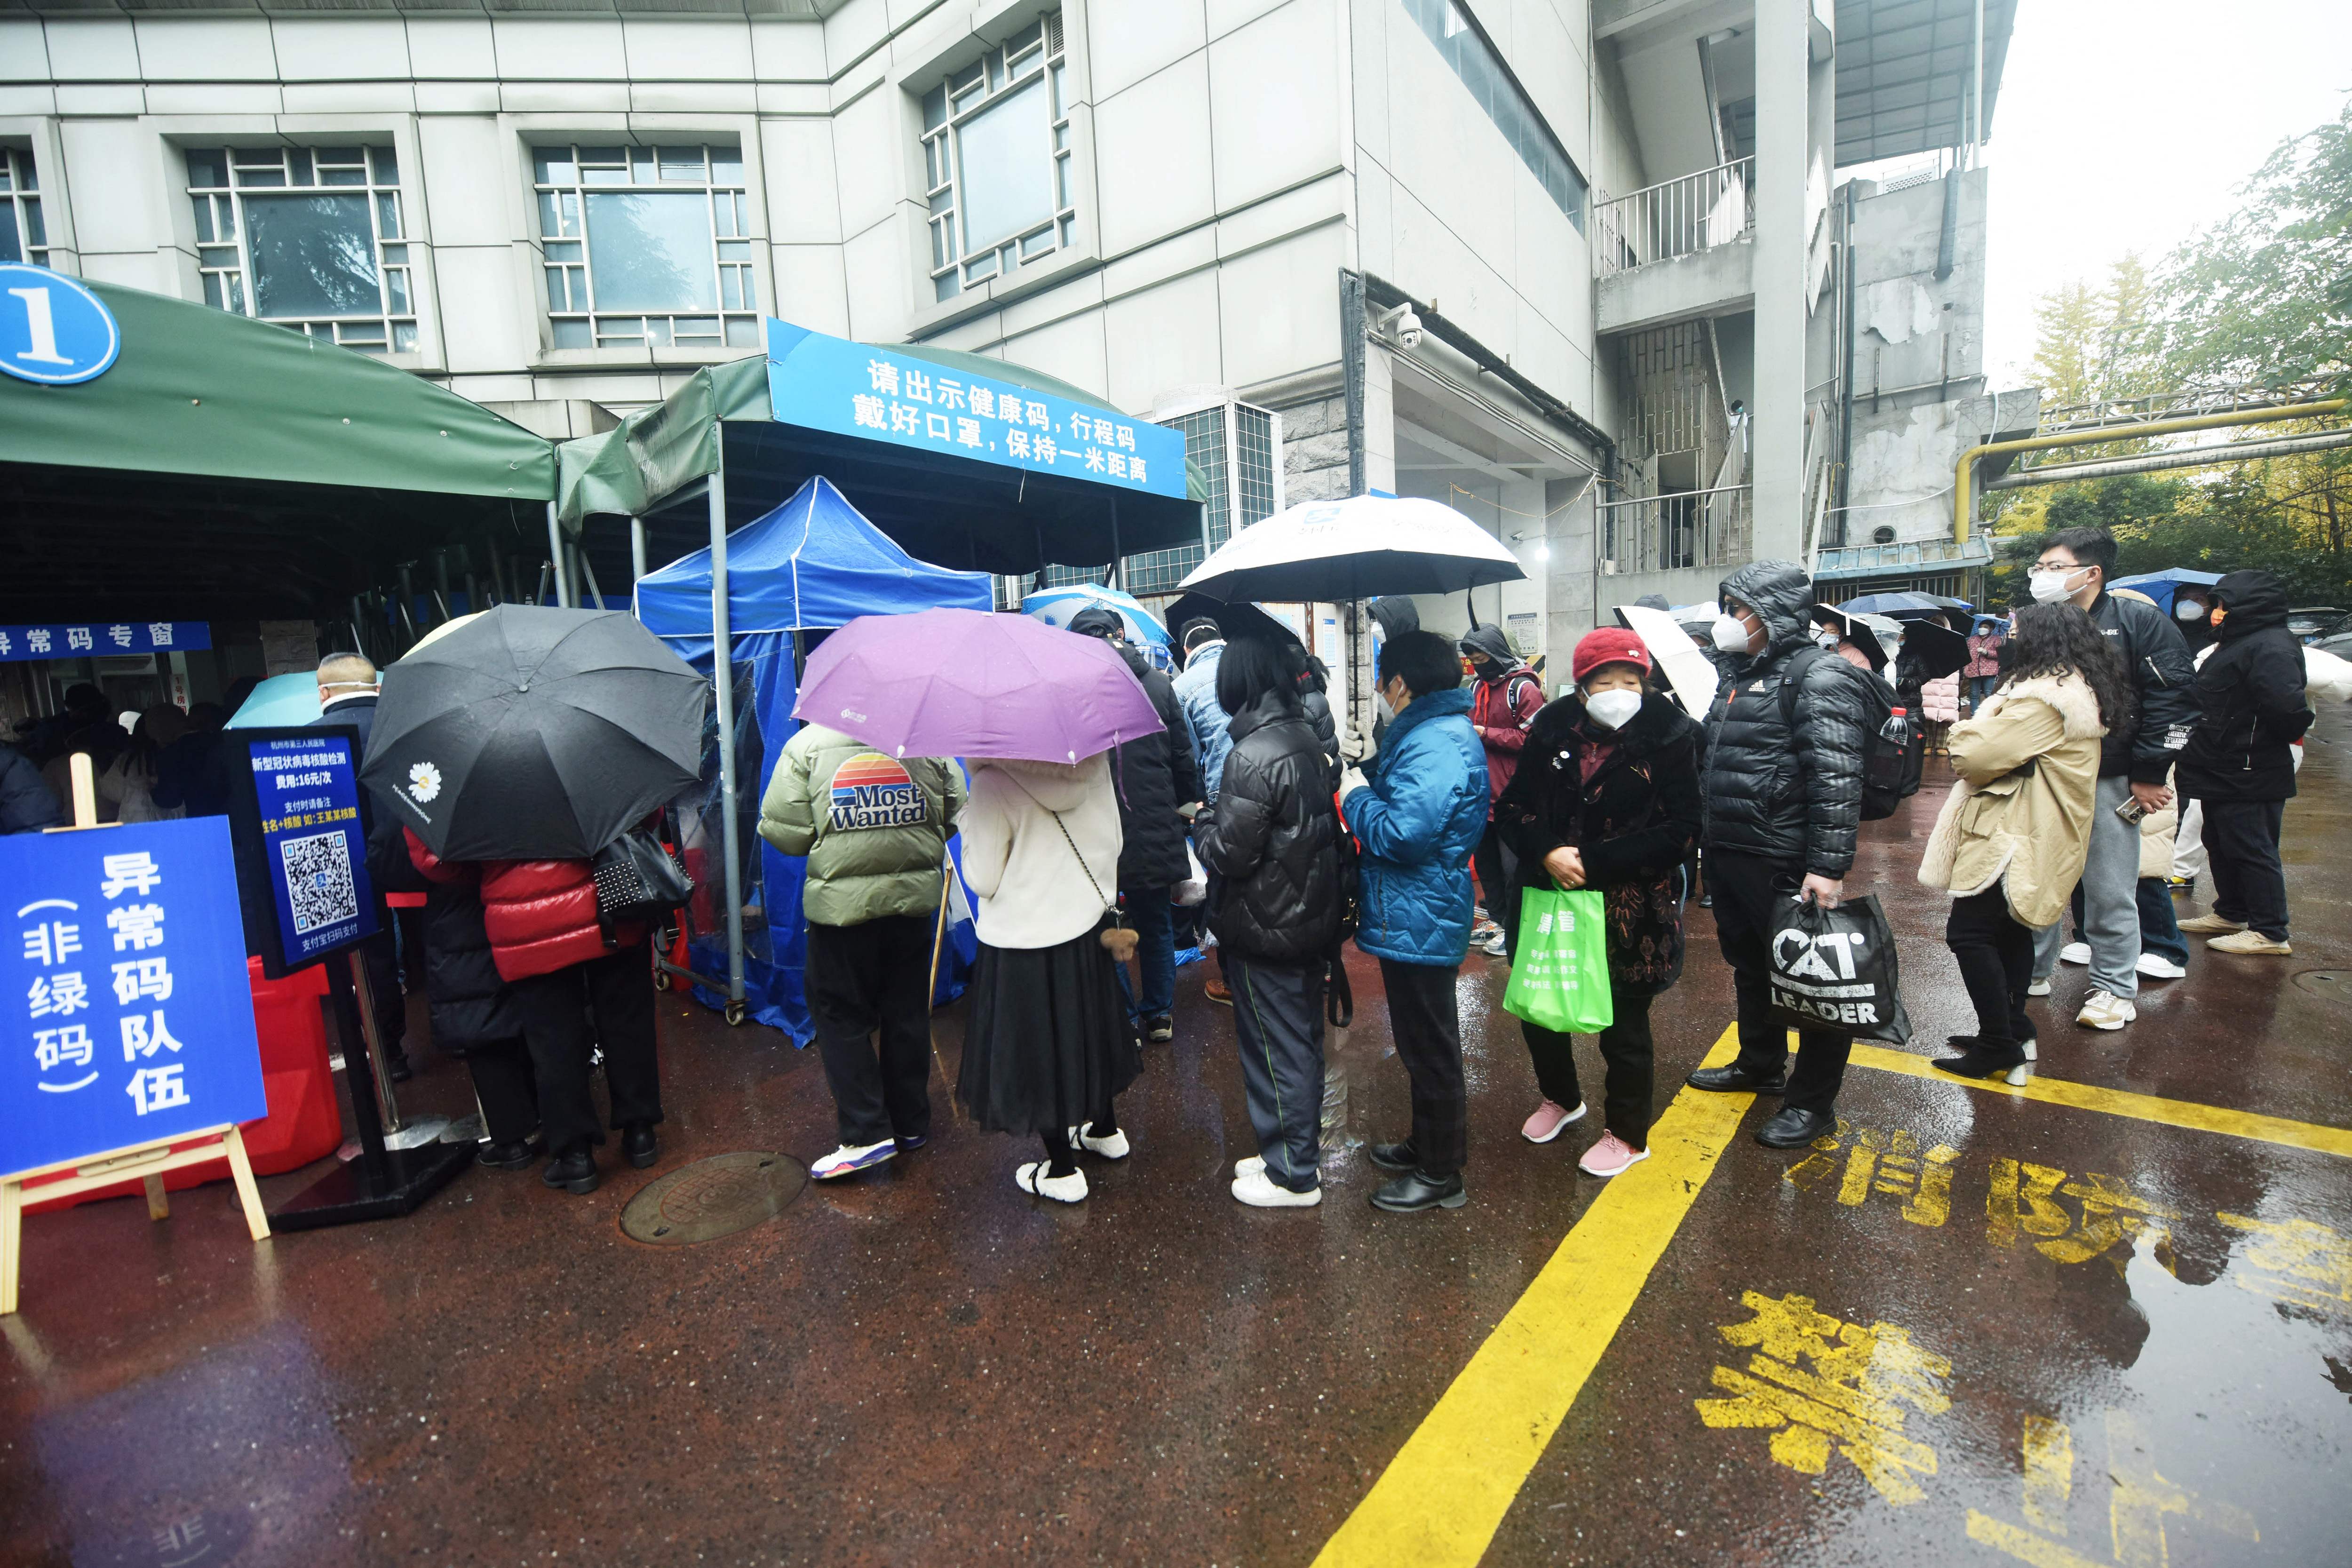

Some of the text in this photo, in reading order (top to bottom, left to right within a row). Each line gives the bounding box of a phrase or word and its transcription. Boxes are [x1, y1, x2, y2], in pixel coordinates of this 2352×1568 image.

[8, 287, 74, 366] 1
[867, 359, 1136, 453] 请出示健康码，行程码
[852, 393, 1147, 484] 戴好口罩，保持一米距离
[271, 738, 326, 750] 杭州市第三人民医院
[252, 752, 346, 772] 新型冠状病毒核酸检测
[284, 796, 331, 813] 支付时请备注
[854, 784, 920, 808] Most
[831, 798, 925, 829] Wanted
[302, 922, 358, 953] 支付宝扫码支付
[1772, 928, 1857, 981] CAT
[101, 852, 191, 1116] 异常码队伍
[1771, 987, 1880, 1024] LEADER
